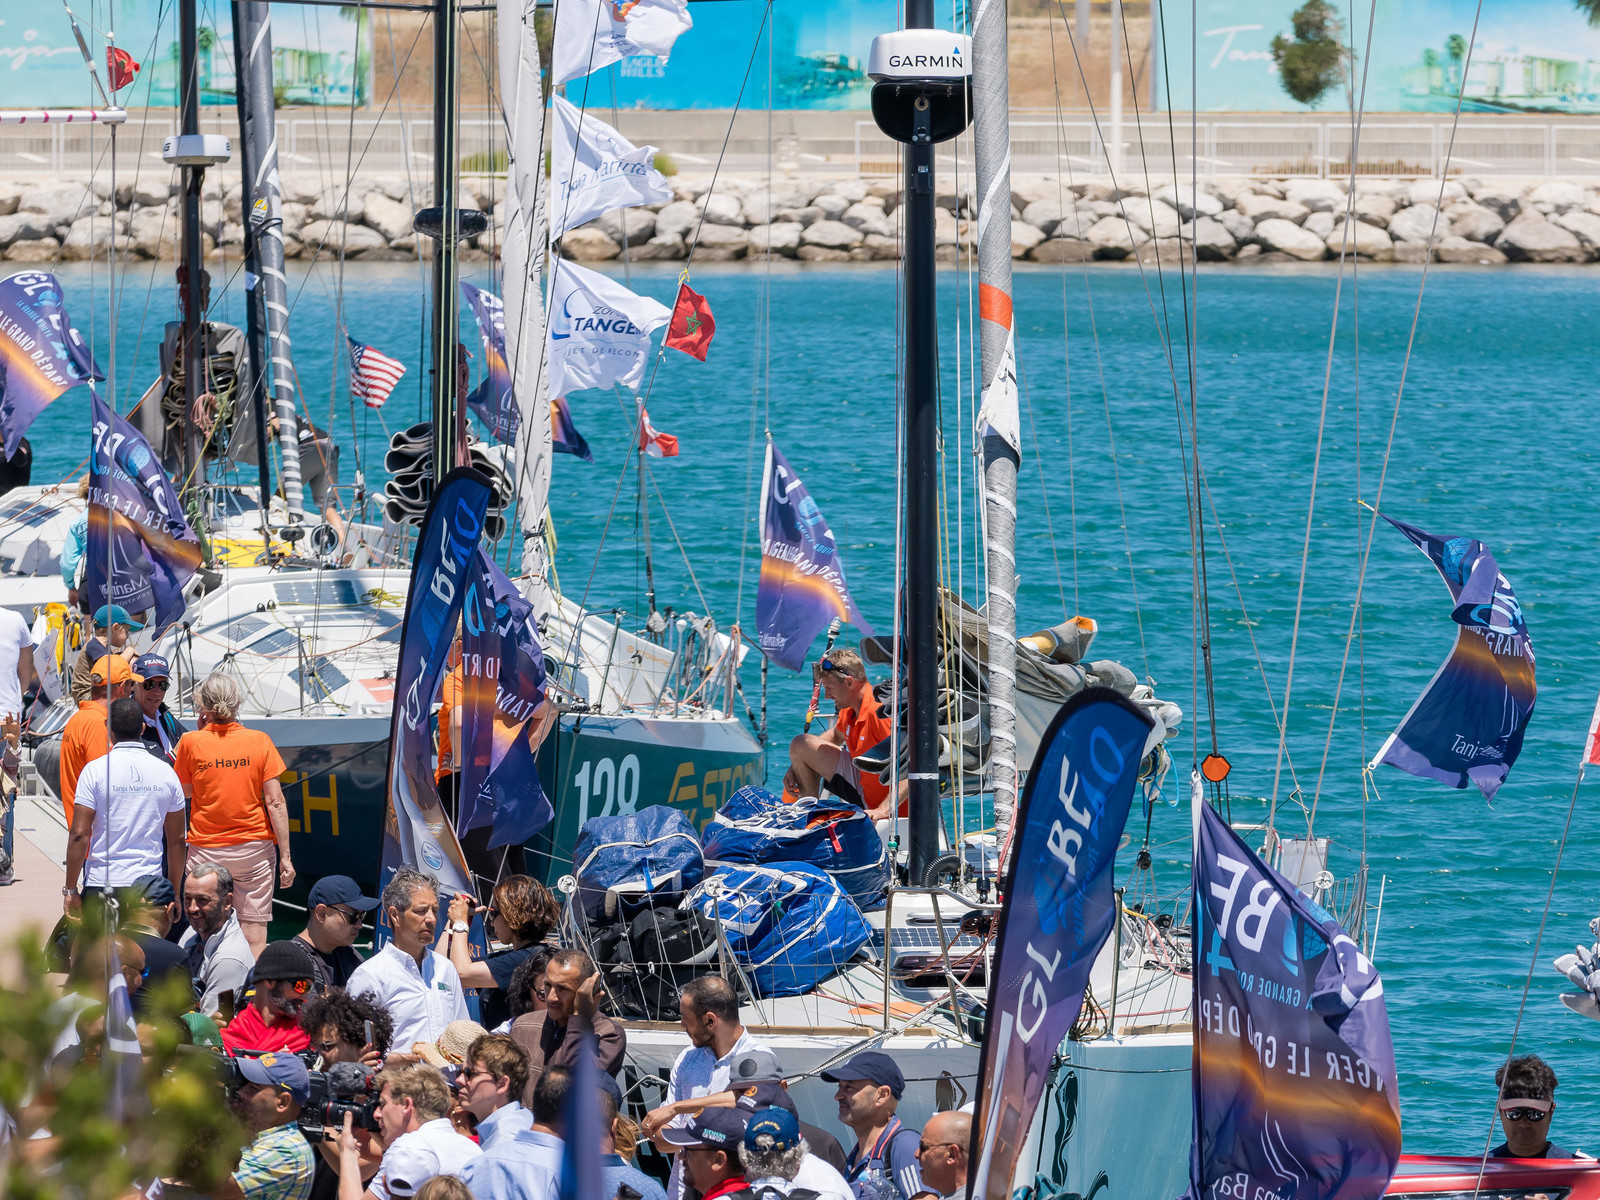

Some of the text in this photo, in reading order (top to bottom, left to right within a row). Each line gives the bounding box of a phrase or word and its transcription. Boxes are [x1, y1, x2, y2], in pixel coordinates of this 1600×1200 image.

[889, 55, 963, 68] GARMIN
[574, 317, 641, 335] TANGE
[7, 323, 36, 351] GRAND
[30, 349, 69, 386] DÉPART
[608, 348, 641, 357] RECON
[198, 757, 250, 773] Sec Hayai
[112, 785, 128, 793] Tanja
[153, 785, 164, 793] Bay
[575, 754, 640, 836] 128
[704, 1128, 726, 1139] SIEMENS
